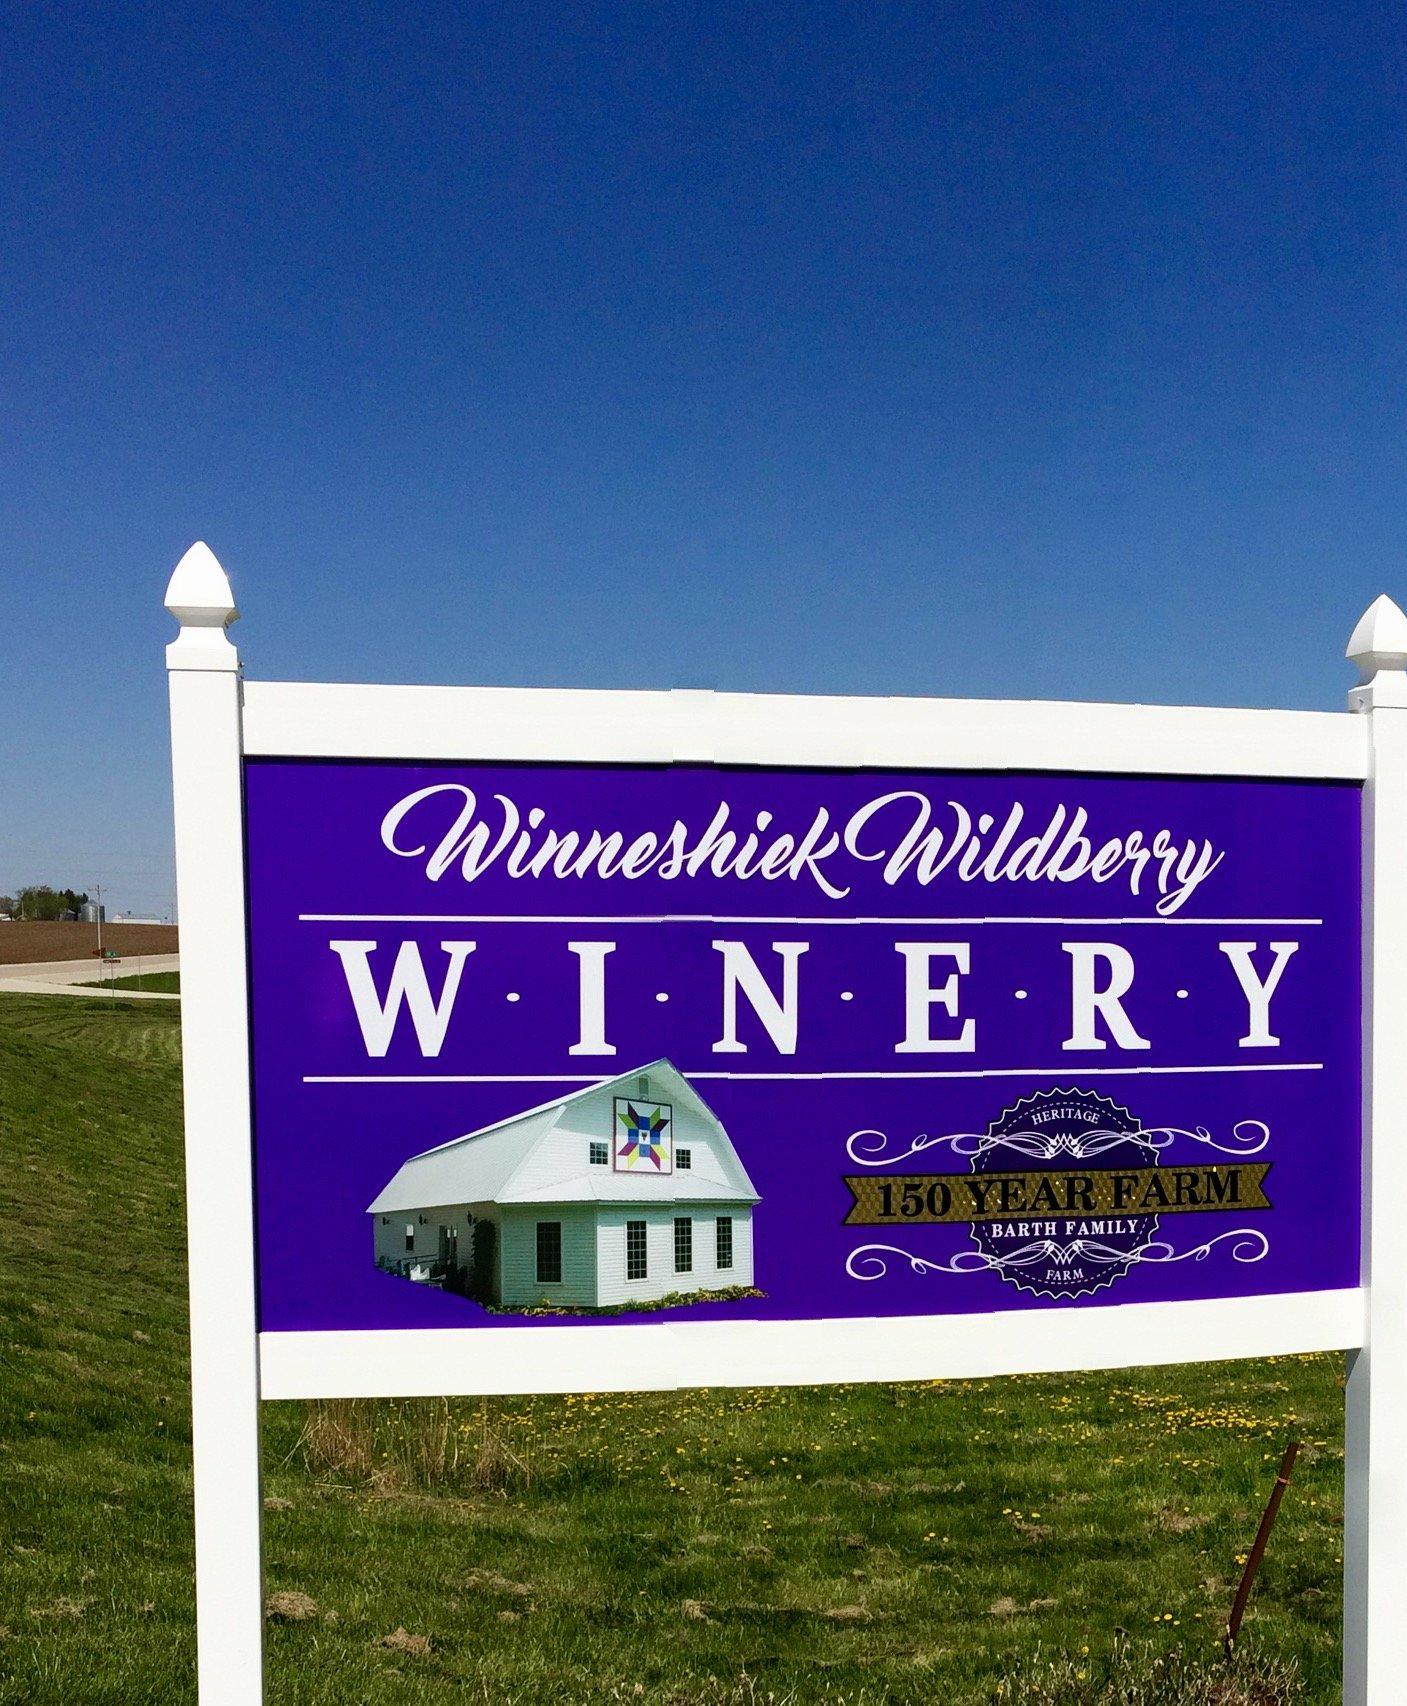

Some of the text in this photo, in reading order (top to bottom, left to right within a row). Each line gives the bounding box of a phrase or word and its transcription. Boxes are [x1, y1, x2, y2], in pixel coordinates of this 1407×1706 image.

[380, 783, 1225, 916] Winneshiek Wildberry
[1031, 1108, 1101, 1126] HERITAGE
[877, 1169, 1242, 1218] 150 YEAR FARM
[991, 1219, 1139, 1238] BARTH FAMILY
[1045, 1268, 1084, 1281] FARM
